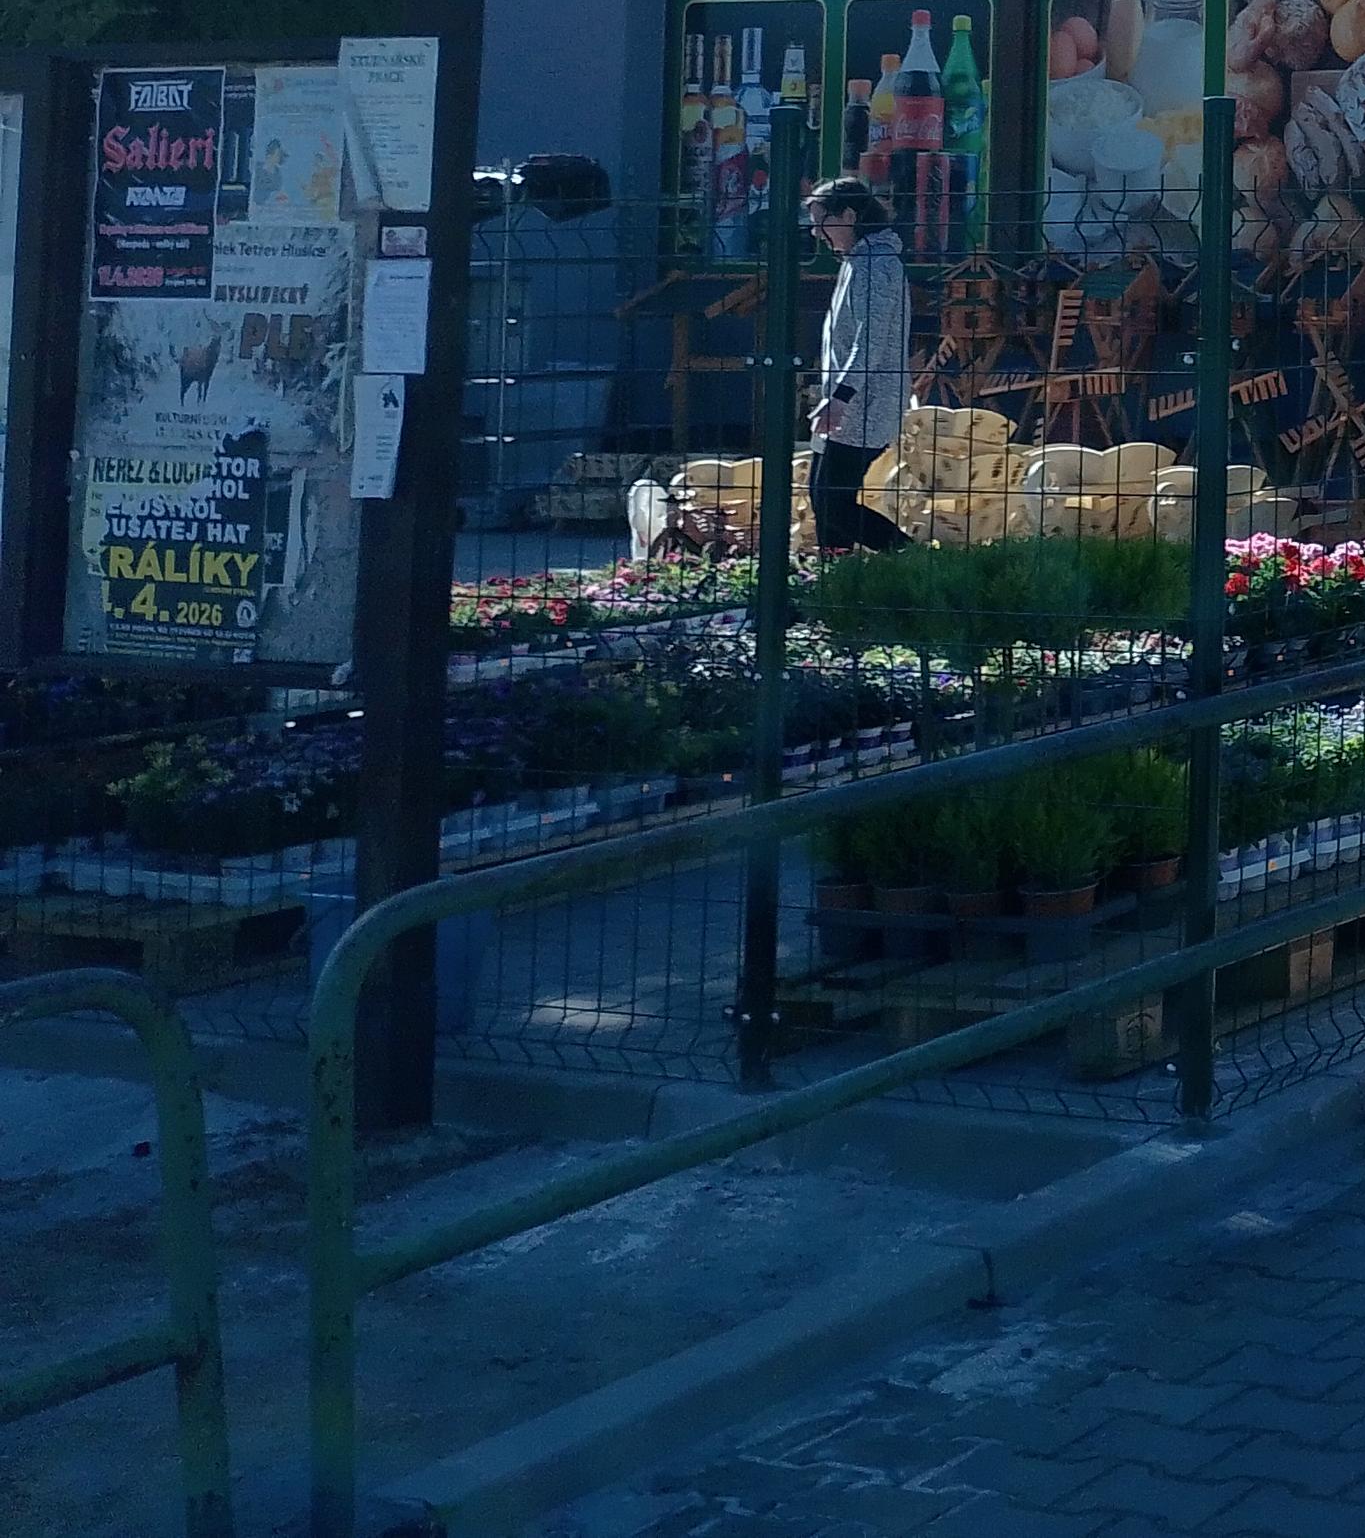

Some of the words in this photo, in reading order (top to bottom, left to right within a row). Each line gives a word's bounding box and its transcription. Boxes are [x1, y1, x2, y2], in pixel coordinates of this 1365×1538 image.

[102, 122, 216, 174] Salieri
[207, 523, 250, 545] HAT
[174, 600, 223, 627] 2026
